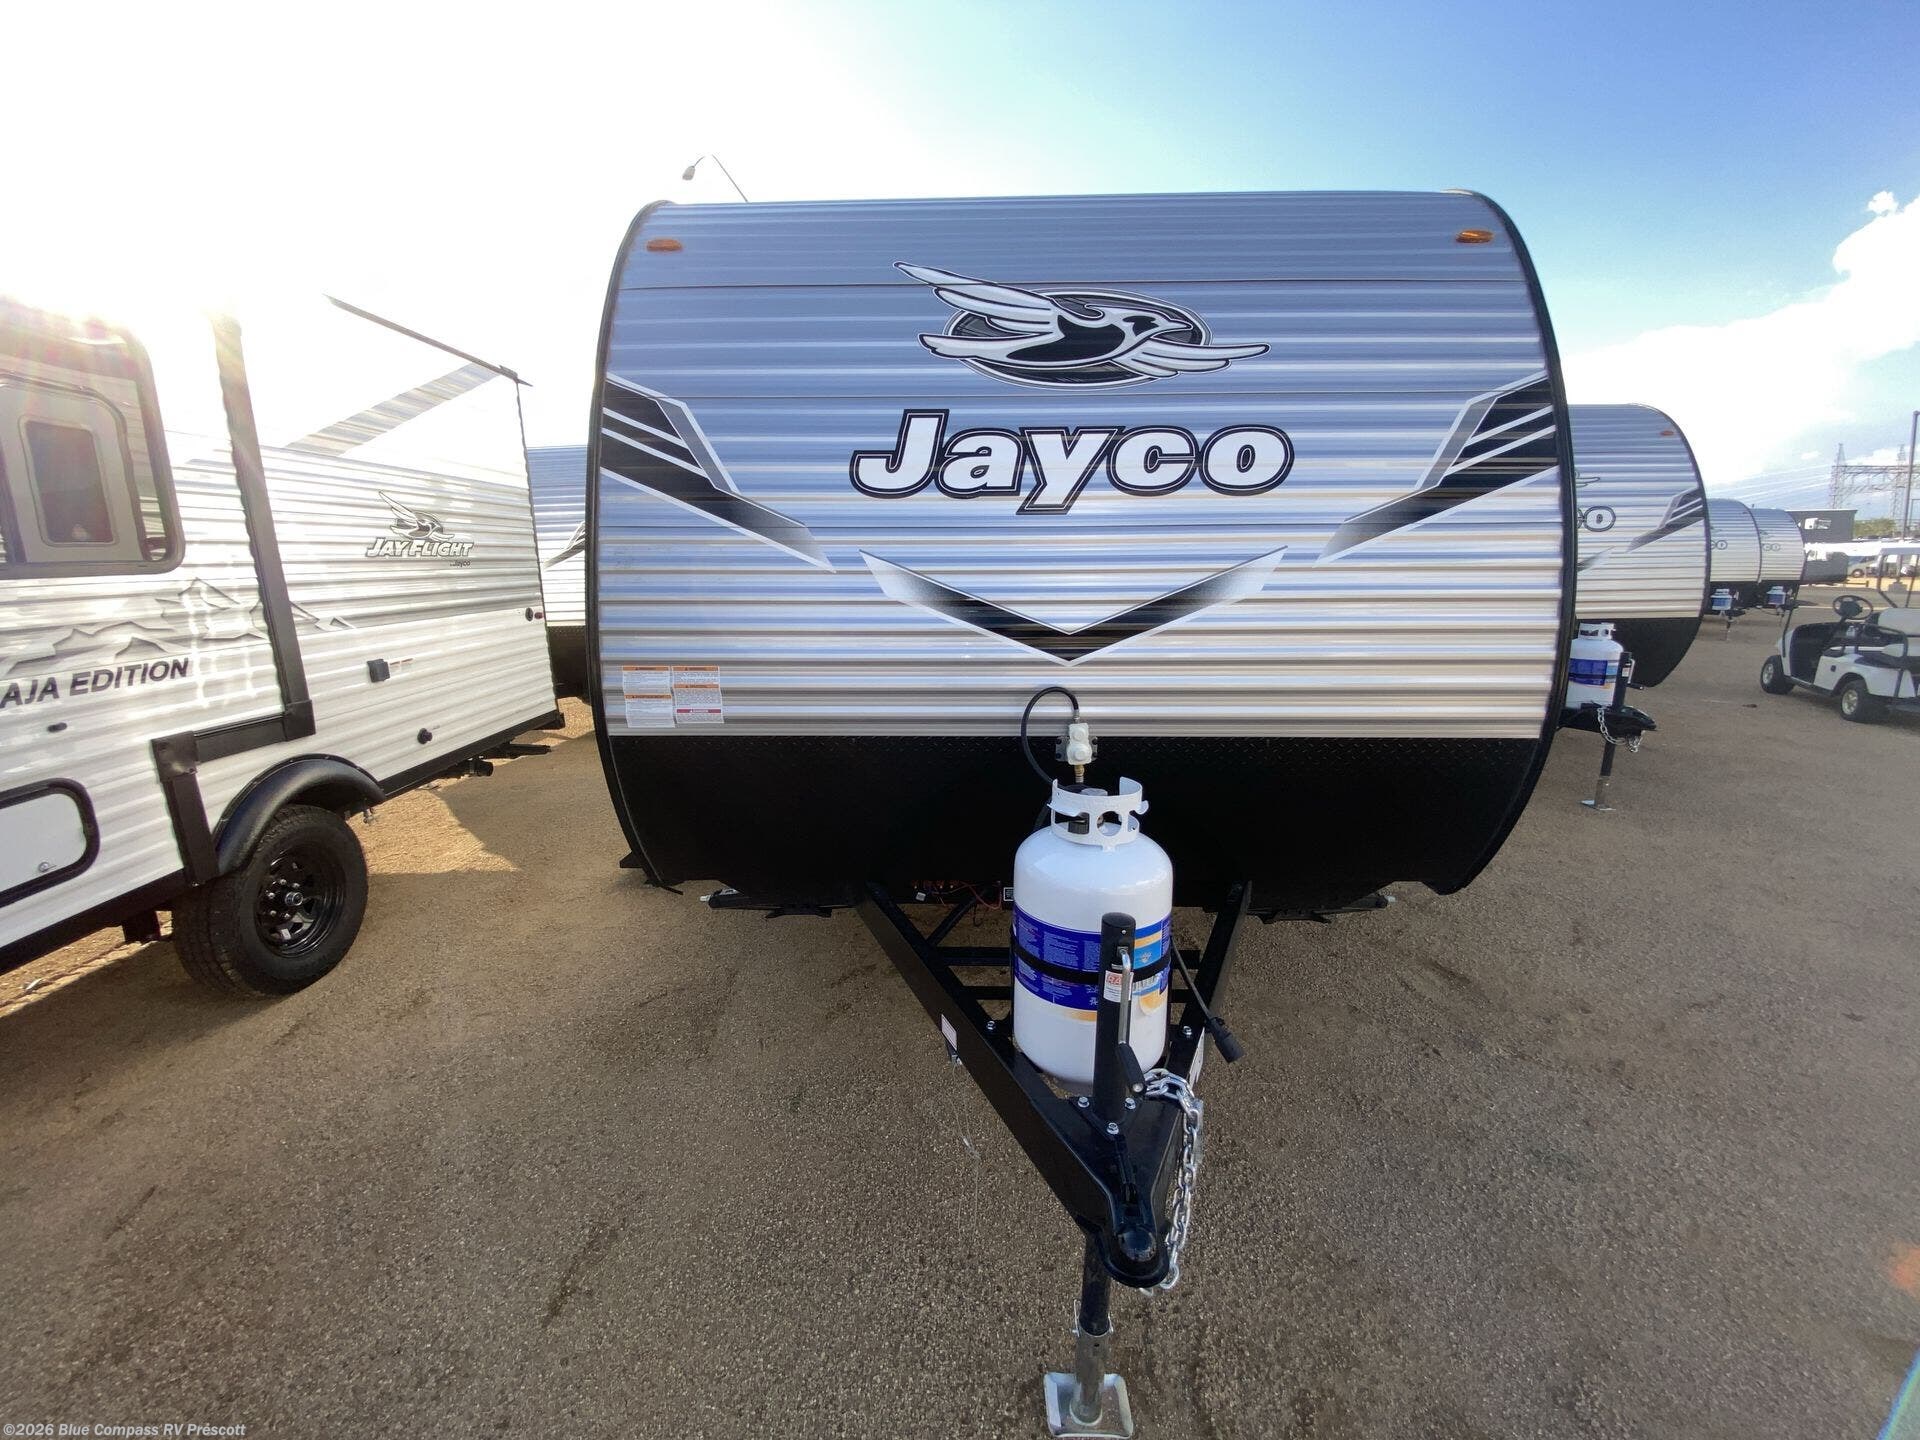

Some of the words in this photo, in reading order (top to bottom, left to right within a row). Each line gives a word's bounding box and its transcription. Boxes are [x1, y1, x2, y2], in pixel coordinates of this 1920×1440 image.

[849, 408, 1295, 515] Jayco
[366, 537, 409, 558] JAY
[408, 539, 474, 557] FLIGHT
[69, 657, 190, 697] EDITION
